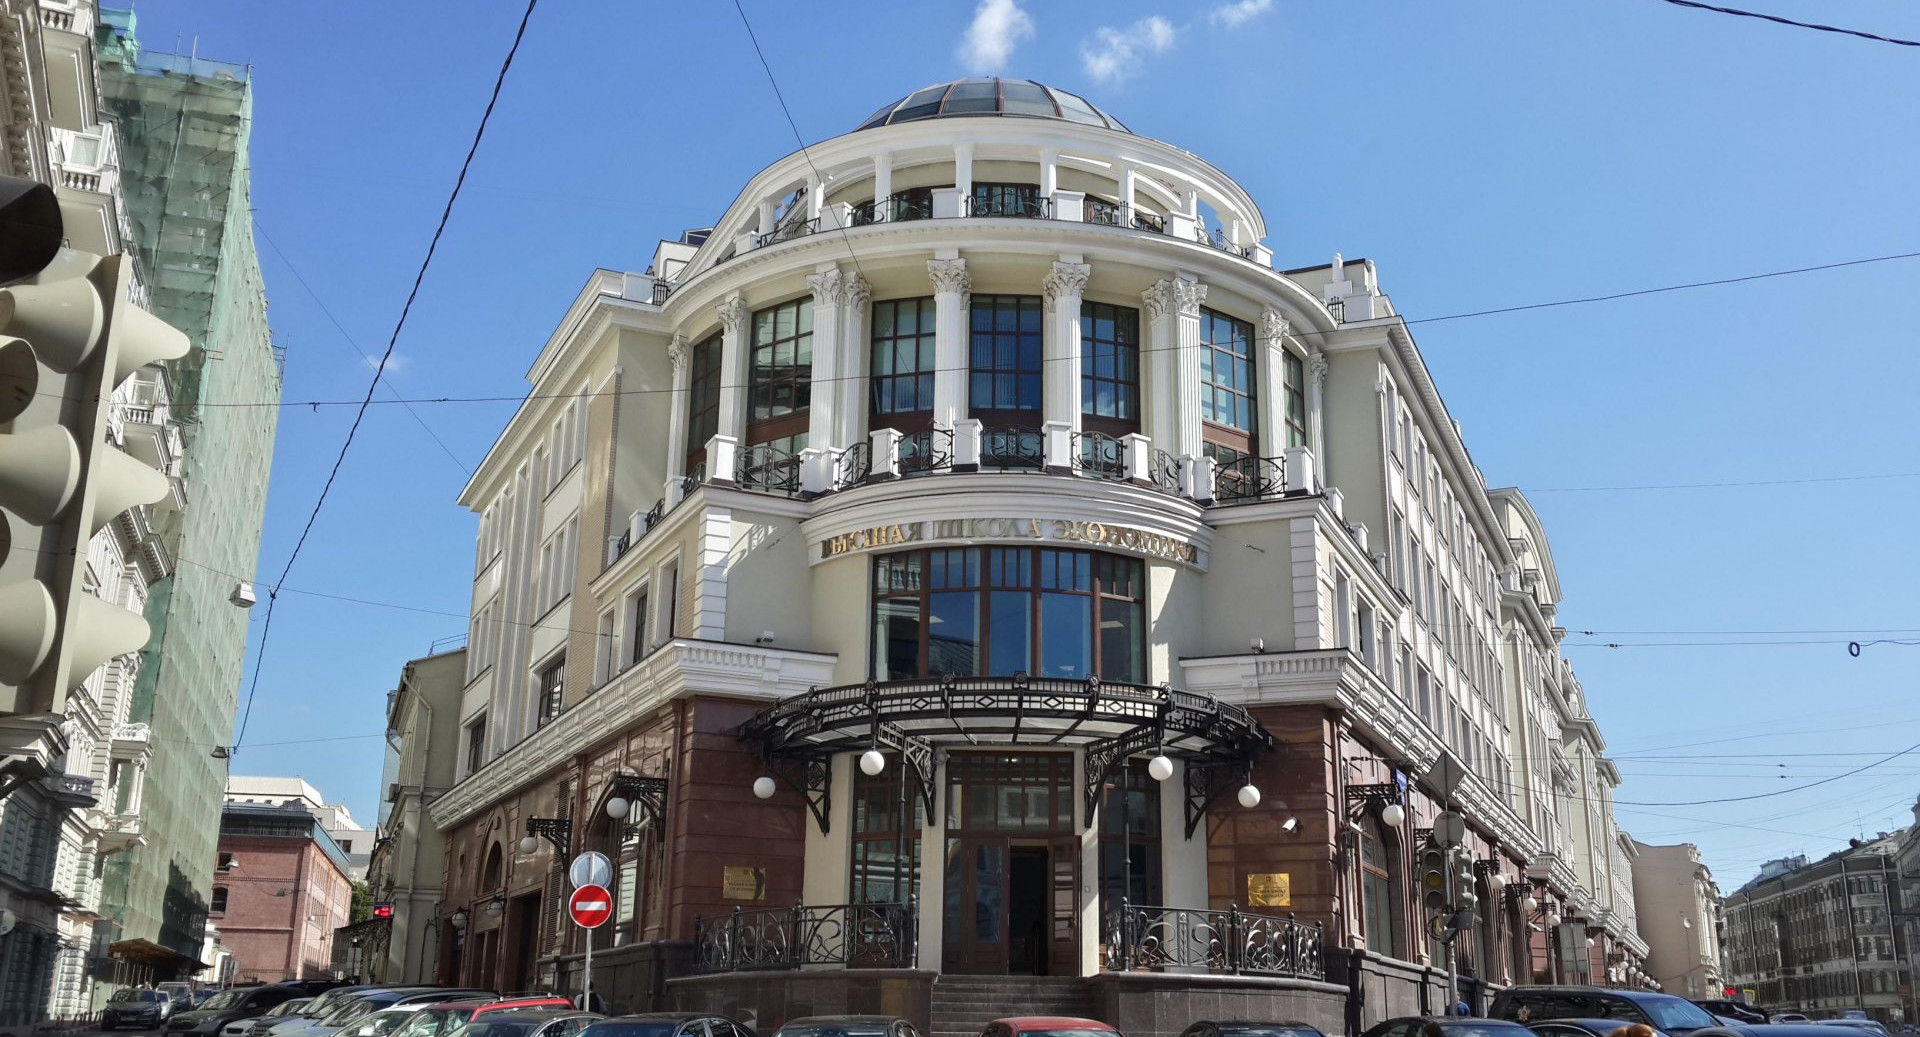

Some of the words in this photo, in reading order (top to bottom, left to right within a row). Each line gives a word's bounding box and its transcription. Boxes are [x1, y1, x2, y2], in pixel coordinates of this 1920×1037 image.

[820, 522, 924, 558] ВЫСШАЯ
[935, 517, 1042, 539] ШКОЛА
[1052, 519, 1199, 564] ЭКОНОМИКИ
